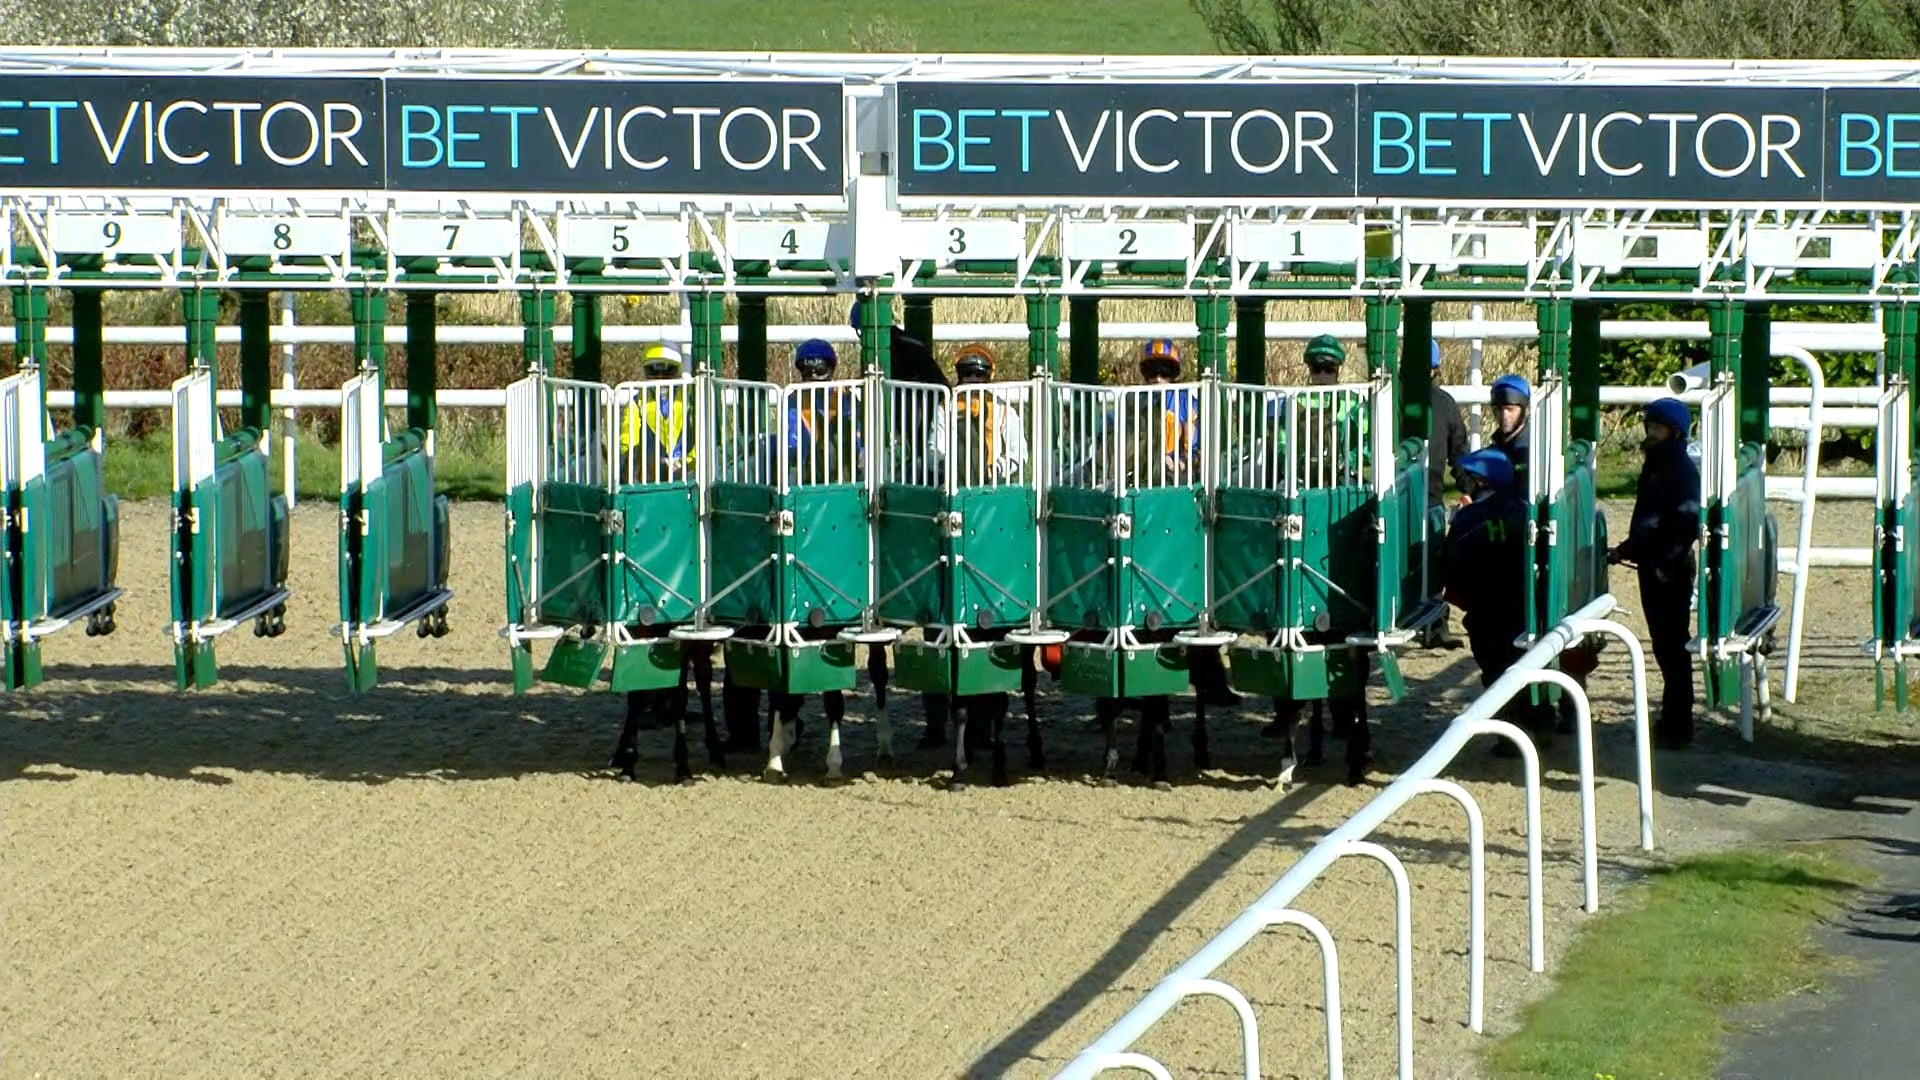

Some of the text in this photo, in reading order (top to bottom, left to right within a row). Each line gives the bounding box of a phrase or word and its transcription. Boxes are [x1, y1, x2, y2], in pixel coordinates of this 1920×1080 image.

[402, 105, 827, 171] BETVICTOR
[913, 109, 1337, 175] BETVICTOR
[1373, 111, 1805, 178] BETVICTOR
[1839, 113, 1920, 177] BE
[103, 222, 121, 247] 9
[273, 224, 292, 250] 8
[443, 226, 461, 250] 7
[611, 226, 629, 252] 5
[780, 229, 799, 255] 4
[948, 229, 967, 255] 3
[1119, 229, 1138, 255] 2
[1290, 230, 1304, 255] 1
